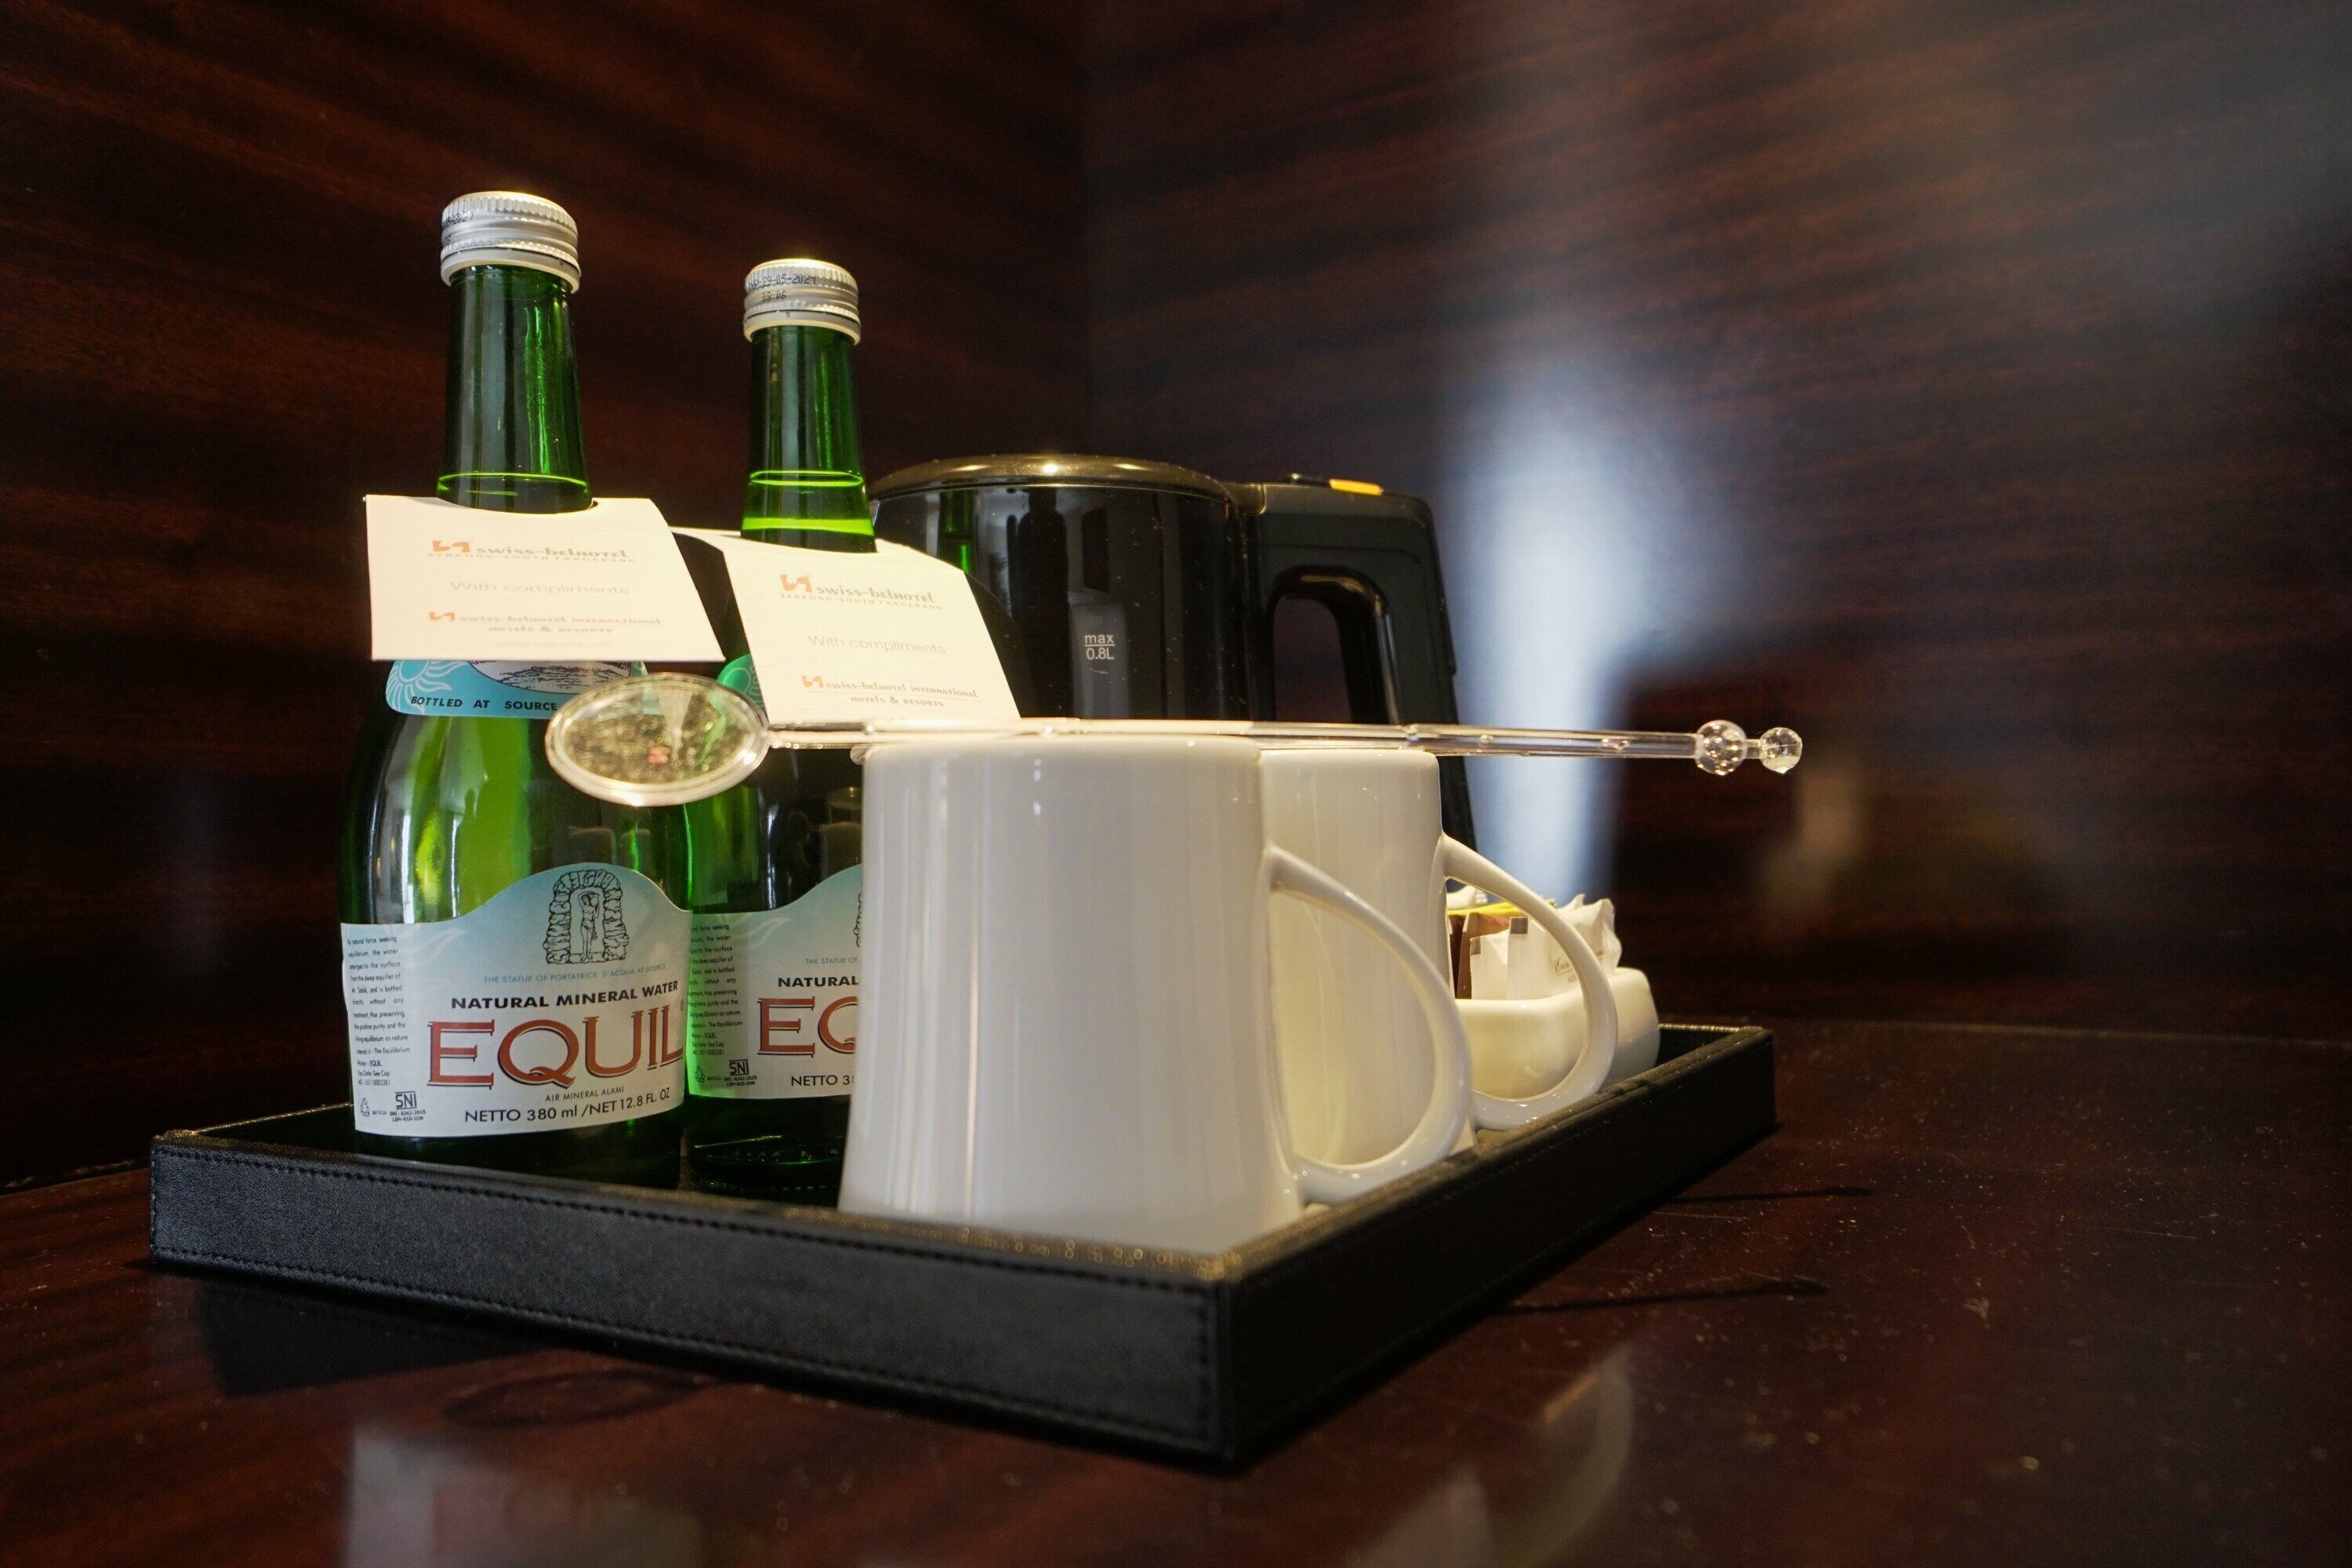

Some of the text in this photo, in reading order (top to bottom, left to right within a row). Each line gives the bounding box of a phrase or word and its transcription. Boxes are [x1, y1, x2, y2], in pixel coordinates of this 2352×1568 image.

[451, 581, 630, 594] With compliments
[808, 635, 947, 655] With compliments
[1085, 635, 1114, 644] max
[1086, 647, 1115, 659] 0.8L
[410, 696, 557, 711] BOTTLED AT SOURCE
[890, 695, 898, 704] &
[503, 975, 532, 983] STATUE
[550, 971, 597, 982] PORTATRICE
[602, 967, 635, 978] D'ACQUA
[778, 975, 858, 988] NATURAL
[451, 980, 679, 1010] NATURAL MINERAL WATER
[379, 1010, 405, 1018] preserving
[426, 1004, 684, 1091] EQUIL
[729, 1061, 750, 1075] SNI
[791, 1075, 838, 1086] NETTO
[395, 1092, 417, 1109] SNI
[562, 1090, 598, 1101] MINERAL
[601, 1086, 624, 1096] ALAMI
[465, 1109, 521, 1123] NETTO
[527, 1108, 557, 1121] 380
[561, 1105, 578, 1119] ml
[620, 1094, 644, 1109] 12.8
[646, 1091, 657, 1104] FL.
[659, 1087, 670, 1100] OZ
